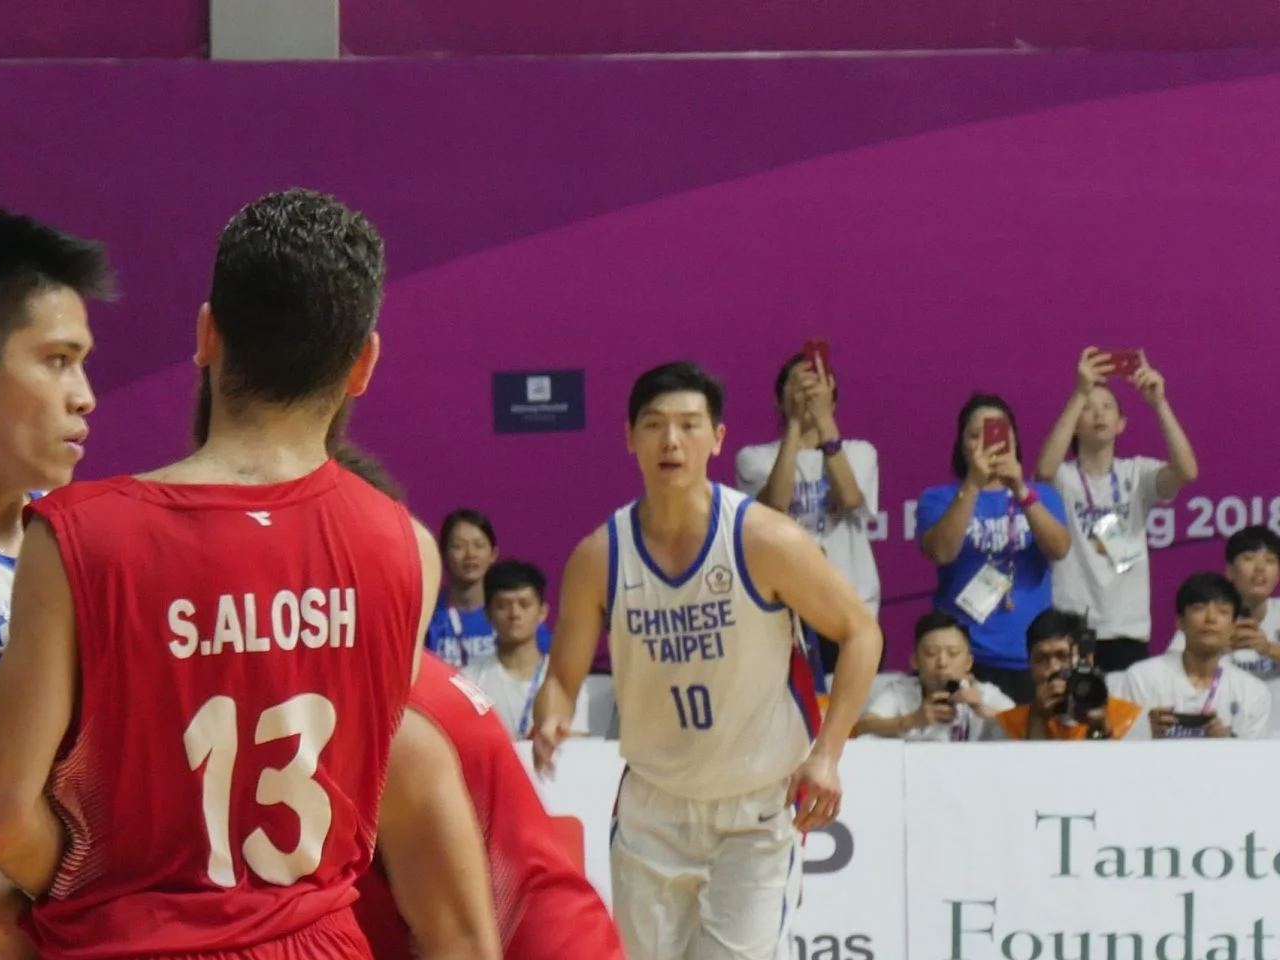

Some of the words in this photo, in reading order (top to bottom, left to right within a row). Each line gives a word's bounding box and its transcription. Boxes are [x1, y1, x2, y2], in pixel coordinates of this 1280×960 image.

[168, 588, 356, 660] S.ALOSH
[627, 599, 736, 636] CHINESE
[642, 632, 725, 663] TAIPEI
[670, 684, 714, 730] 10
[184, 692, 337, 887] 13
[1034, 808, 1280, 881] Tanot
